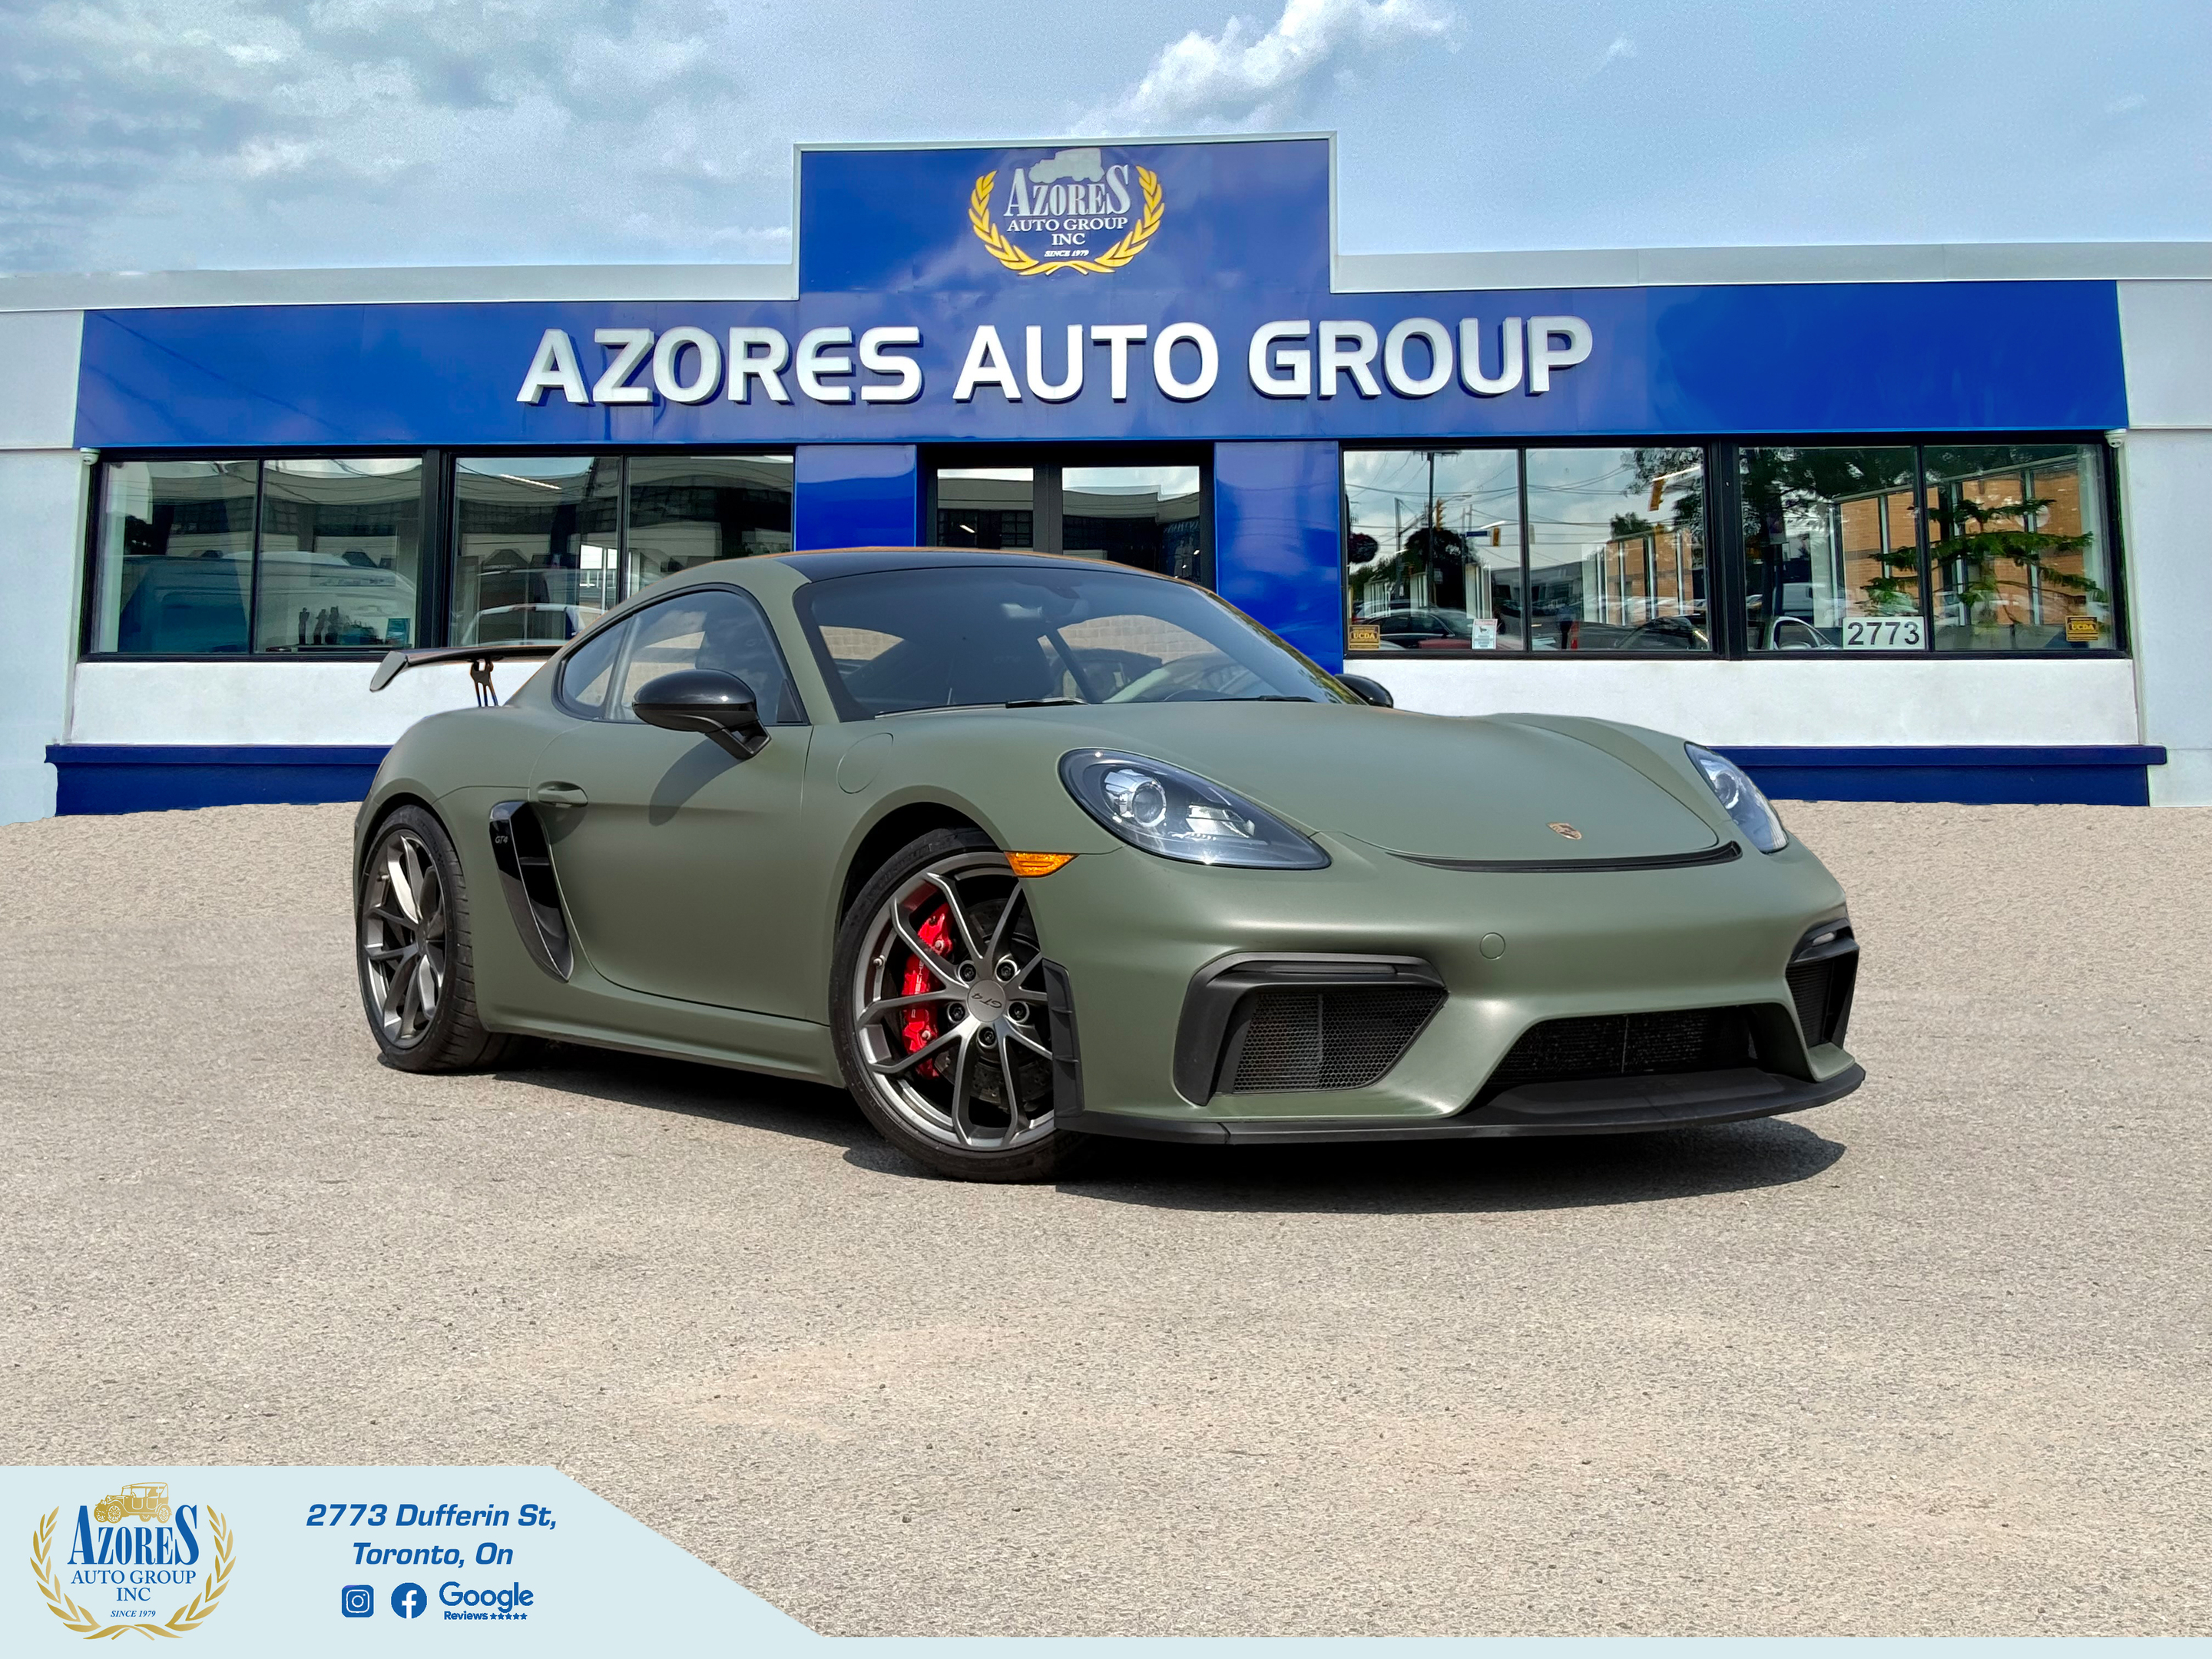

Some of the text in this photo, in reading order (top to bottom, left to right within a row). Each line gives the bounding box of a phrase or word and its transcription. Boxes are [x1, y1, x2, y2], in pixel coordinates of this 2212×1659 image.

[1003, 164, 1131, 217] AZORES
[1007, 217, 1128, 232] AUTO GROUP
[1051, 233, 1086, 246] INC
[517, 316, 1594, 404] AZORES AUTO GROUP
[1847, 621, 1920, 646] 2773
[495, 835, 508, 844] GT4
[971, 993, 1002, 1008] GT4
